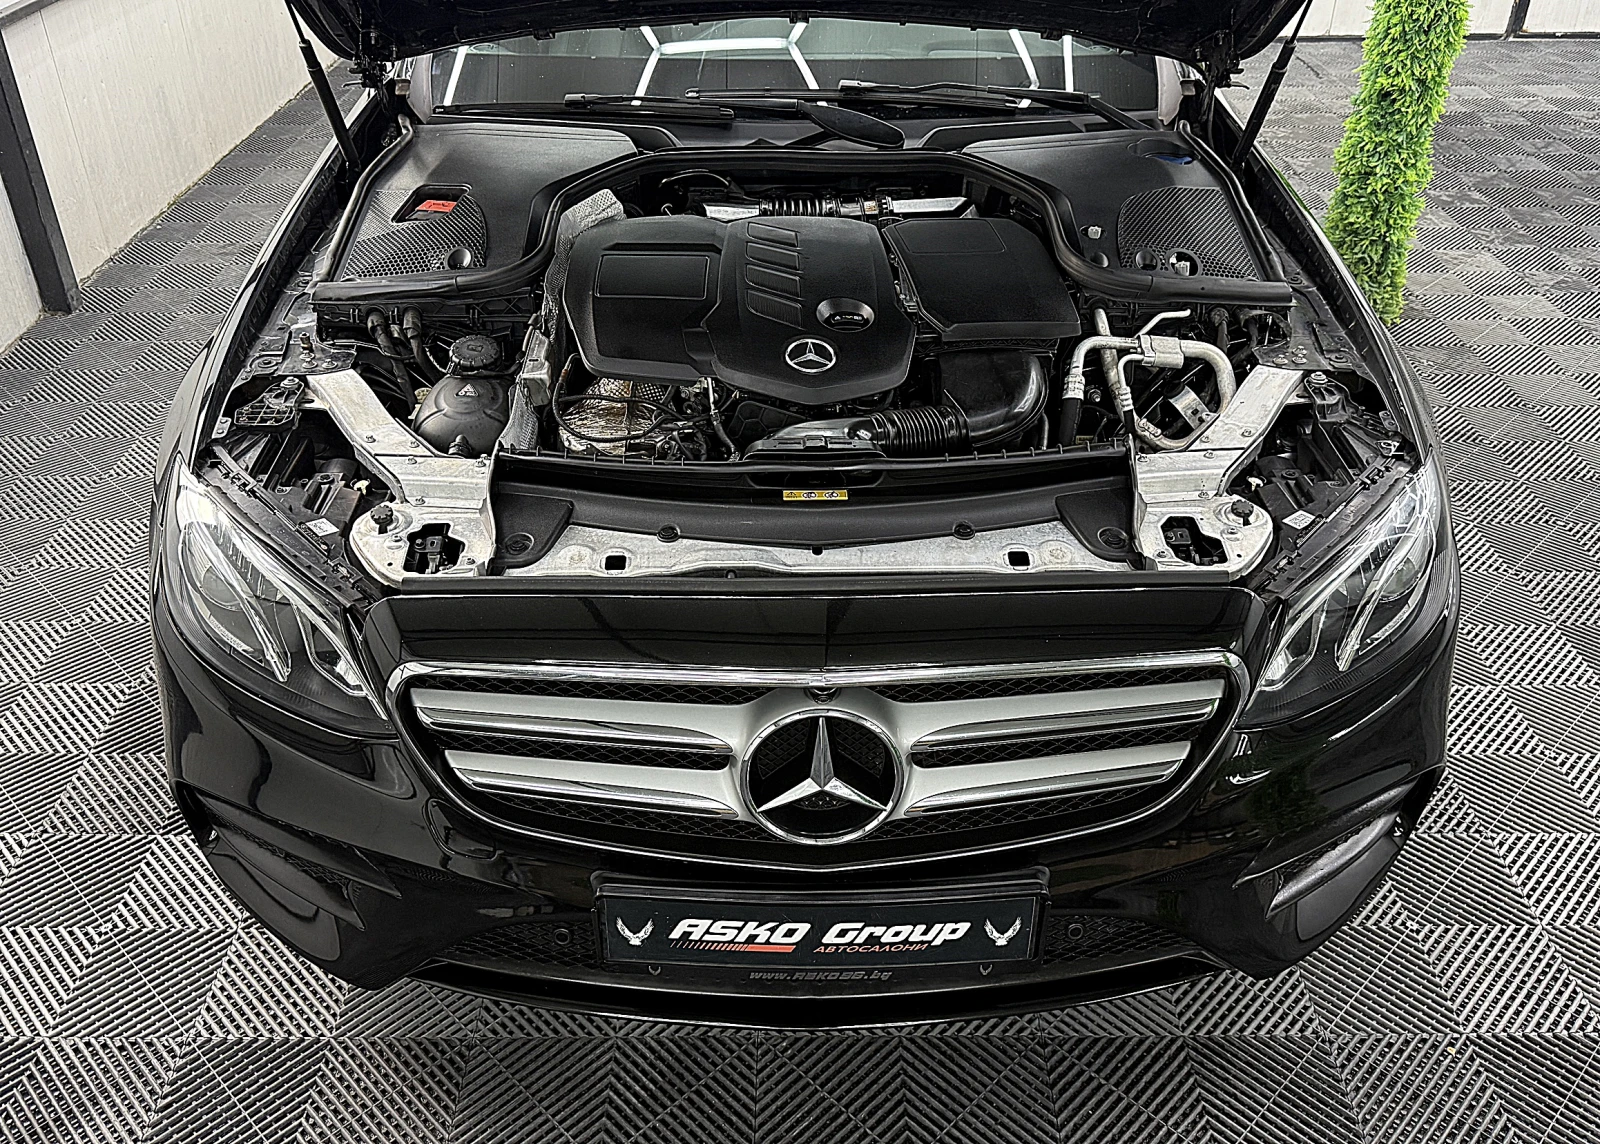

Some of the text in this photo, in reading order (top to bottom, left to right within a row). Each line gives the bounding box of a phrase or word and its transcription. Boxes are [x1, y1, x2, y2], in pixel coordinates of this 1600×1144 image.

[668, 918, 972, 946] ASKO Group
[813, 943, 929, 953] АВТОСАЛОНИ
